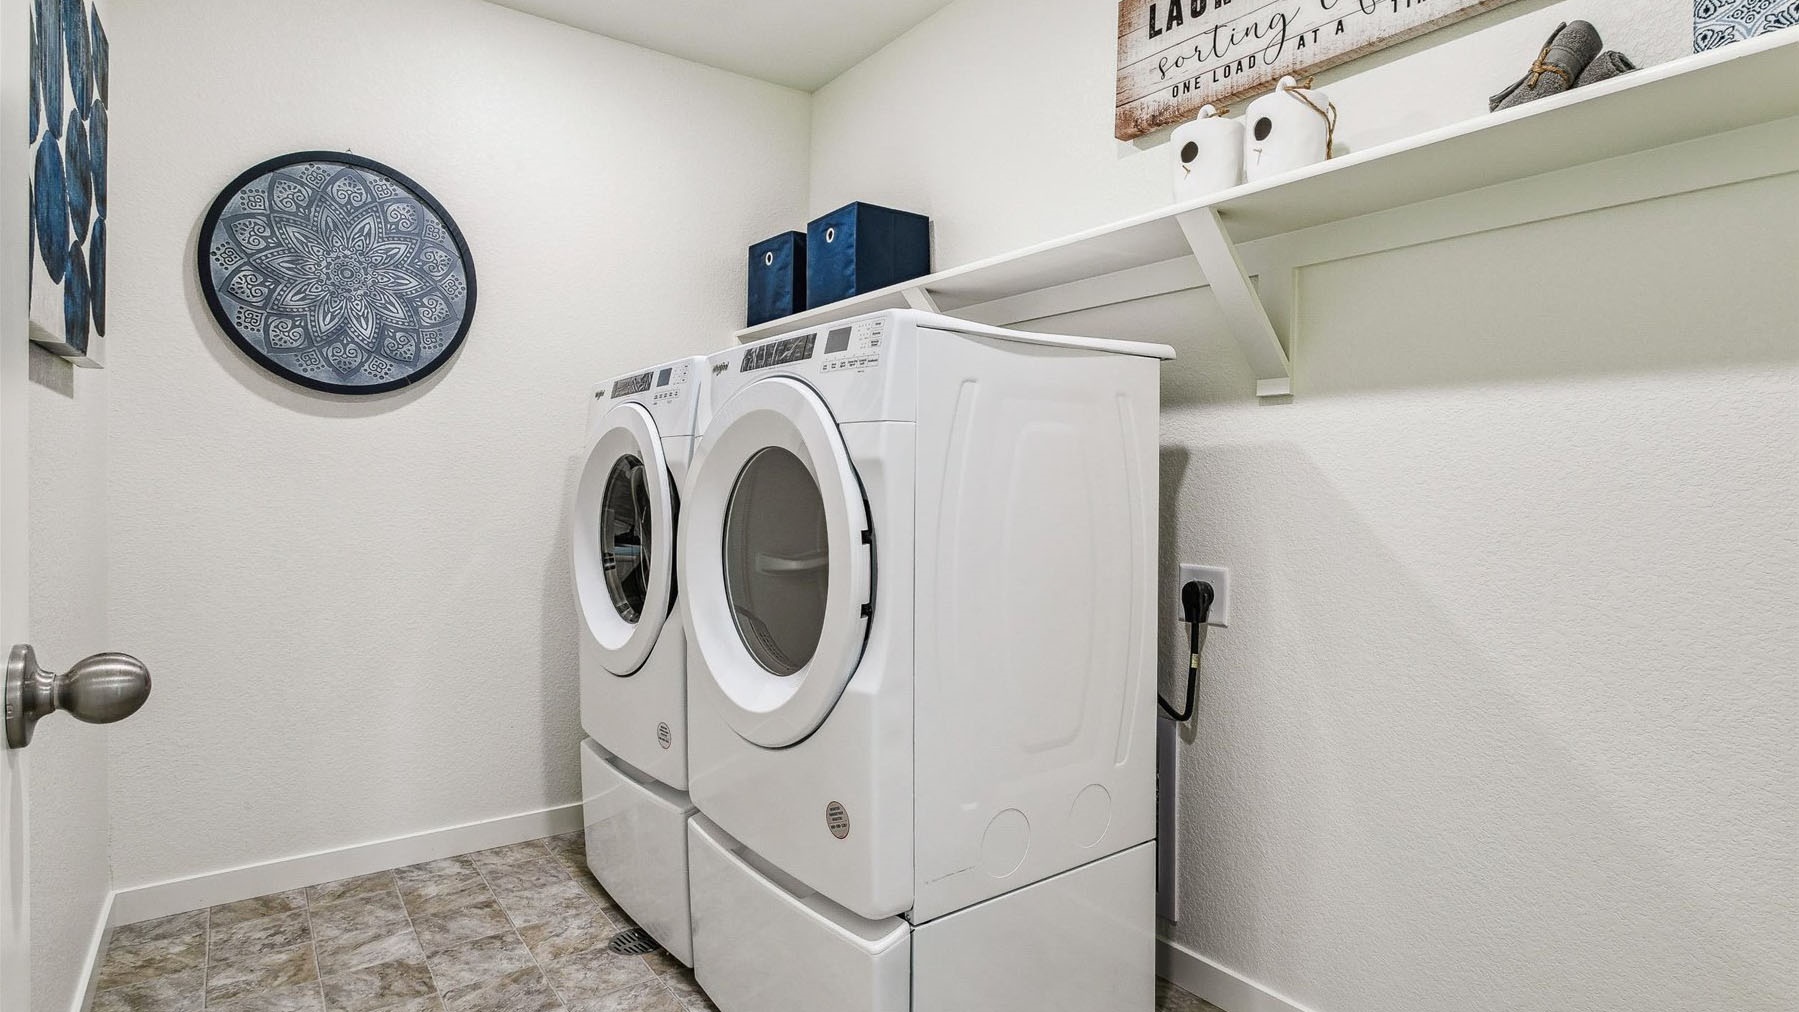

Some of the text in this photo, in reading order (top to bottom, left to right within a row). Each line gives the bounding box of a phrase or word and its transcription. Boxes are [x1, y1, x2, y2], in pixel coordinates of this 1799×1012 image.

[1149, 0, 1232, 39] LAU
[1158, 6, 1301, 80] sorting
[1172, 76, 1201, 98] ONE
[1212, 55, 1256, 83] LOAD
[1297, 28, 1320, 50] AT
[1335, 19, 1344, 35] A
